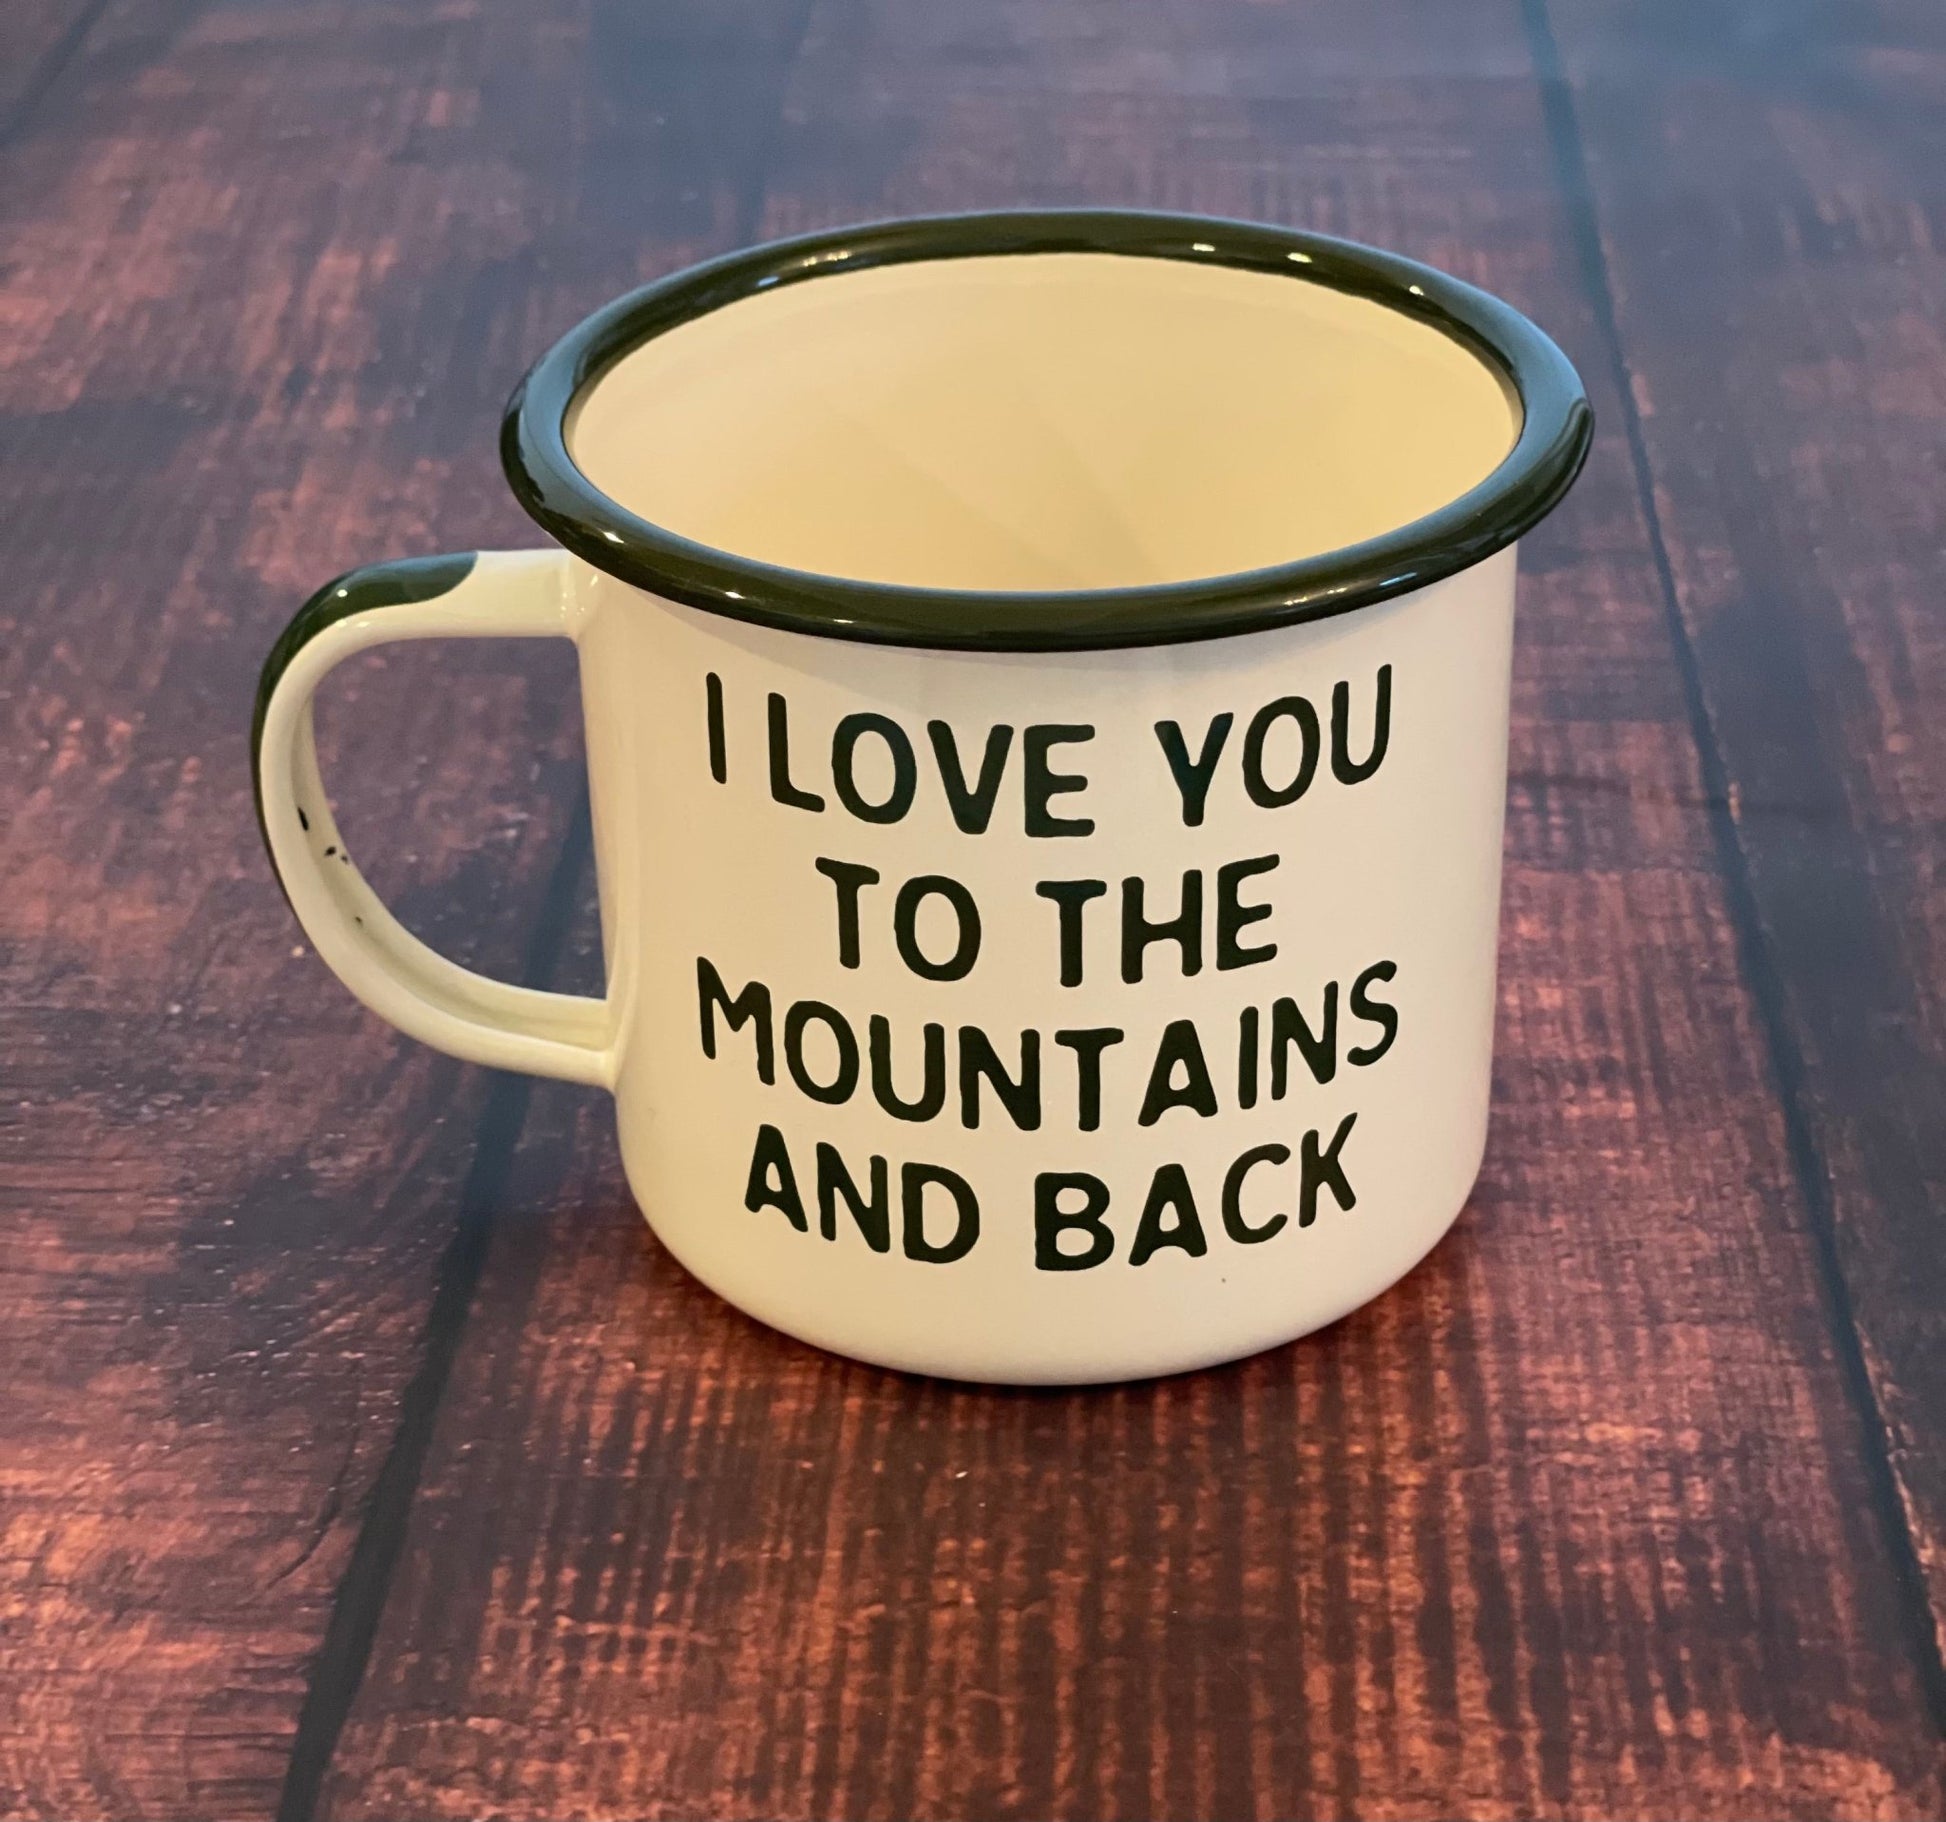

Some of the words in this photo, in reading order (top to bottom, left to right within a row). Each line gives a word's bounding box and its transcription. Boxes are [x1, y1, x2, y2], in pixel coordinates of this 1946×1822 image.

[705, 671, 727, 785] I
[767, 692, 1096, 839] LOVE
[1153, 663, 1392, 828] YOU
[814, 856, 982, 982] TO
[1035, 853, 1280, 988] THE
[696, 956, 1399, 1133] MOUNTAINS
[744, 1123, 981, 1265] AND
[1034, 1112, 1358, 1272] BACK
